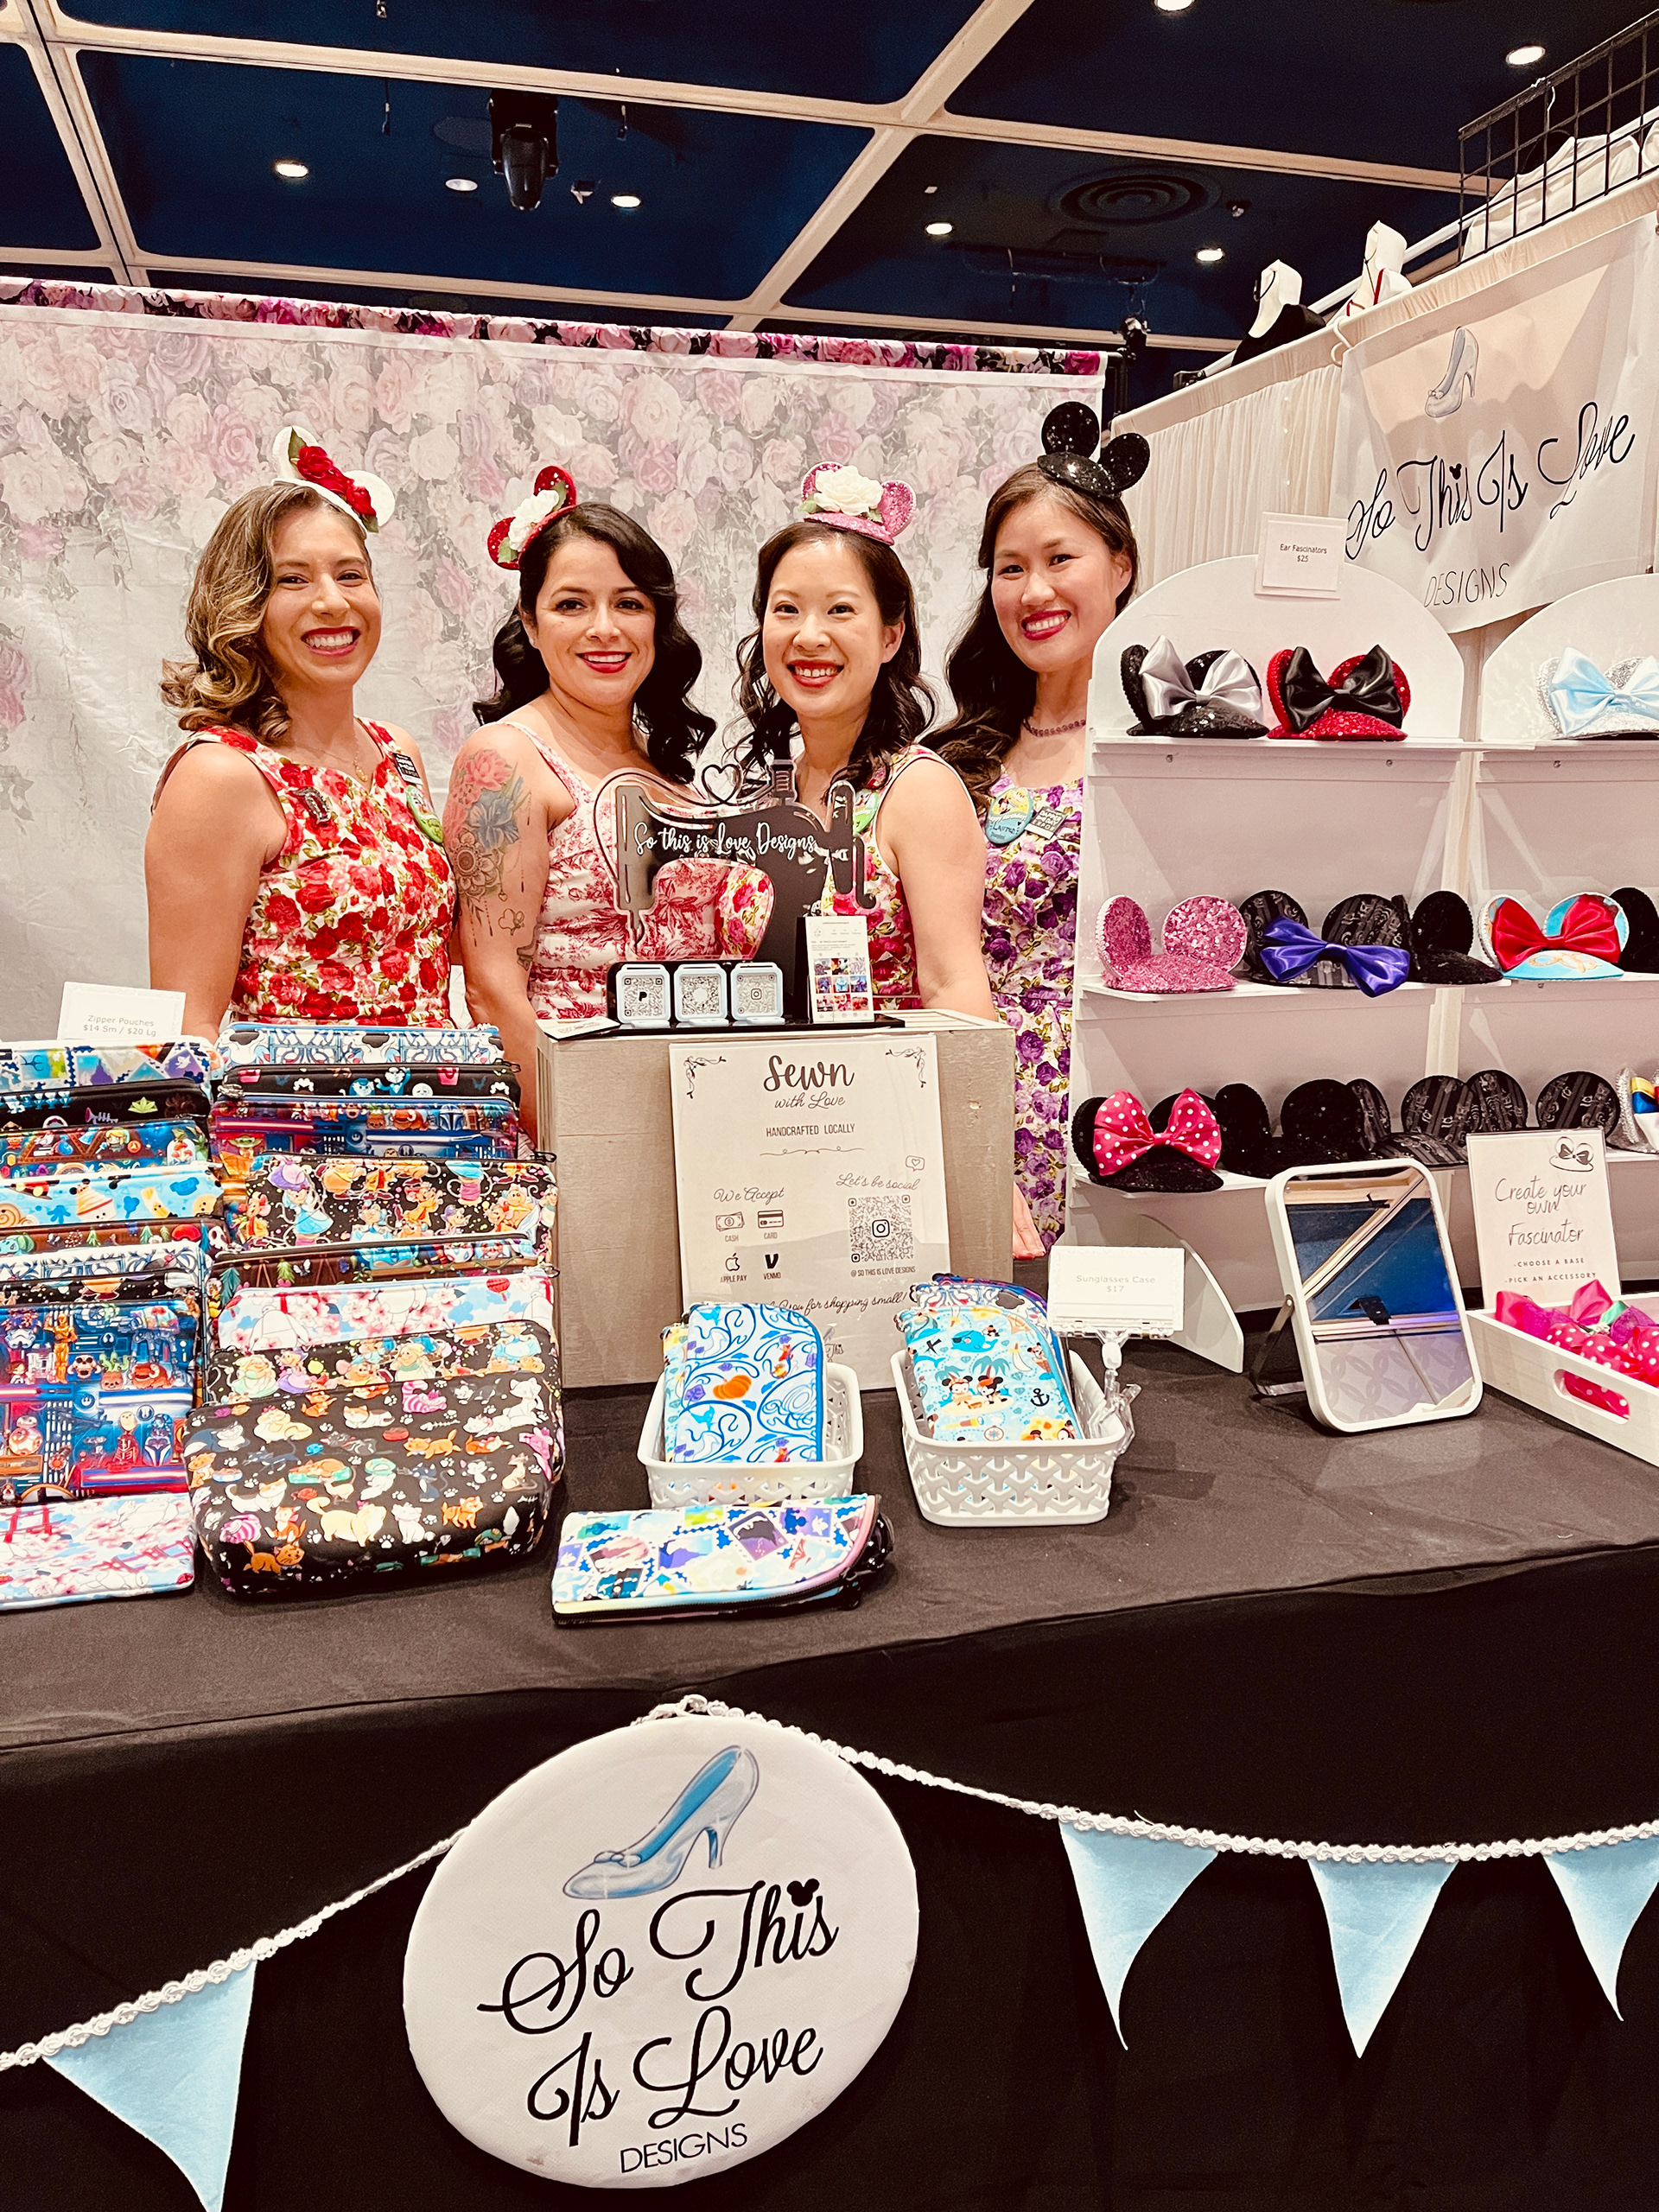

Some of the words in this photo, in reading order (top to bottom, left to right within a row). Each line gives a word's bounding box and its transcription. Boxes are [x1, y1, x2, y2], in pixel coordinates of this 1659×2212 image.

[1344, 467, 1396, 560] So
[1397, 454, 1472, 551] This
[1477, 429, 1529, 533] Is
[1537, 401, 1636, 520] Love
[1292, 544, 1327, 554] Fascinators
[1424, 562, 1510, 608] DESIGNS
[633, 822, 658, 855] So
[658, 827, 692, 851] this
[696, 833, 709, 851] is
[716, 822, 752, 855] Love
[756, 822, 816, 861] Designs
[87, 1014, 116, 1024] Zipper
[119, 1017, 155, 1027] Pouches
[147, 1028, 156, 1037] Lg
[763, 1055, 855, 1091] Sewn
[774, 1092, 805, 1109] with
[808, 1090, 846, 1109] Love
[766, 1125, 819, 1137] HANDCRAFTED
[824, 1123, 855, 1135] LOCALLY
[836, 1173, 869, 1188] Let's
[871, 1175, 884, 1187] be
[886, 1179, 920, 1191] social
[714, 1188, 741, 1203] We
[743, 1186, 785, 1205] Accept
[1495, 1175, 1547, 1202] Create
[1554, 1183, 1587, 1209] your
[1527, 1200, 1559, 1215] own
[1509, 1218, 1585, 1246] Fascinator
[736, 1274, 747, 1282] PAY
[881, 1267, 894, 1275] LOVE
[1077, 1275, 1129, 1284] Sunglasses
[1132, 1275, 1155, 1284] Case
[1548, 1272, 1597, 1281] ACCESSORY
[804, 1298, 823, 1316] for
[824, 1296, 869, 1313] shopping
[871, 1291, 907, 1306] small!
[476, 1908, 634, 2035] So
[649, 1878, 840, 2002] This
[527, 2031, 620, 2147] Is
[632, 2005, 823, 2130] Love
[620, 2122, 749, 2174] DESIGNS
